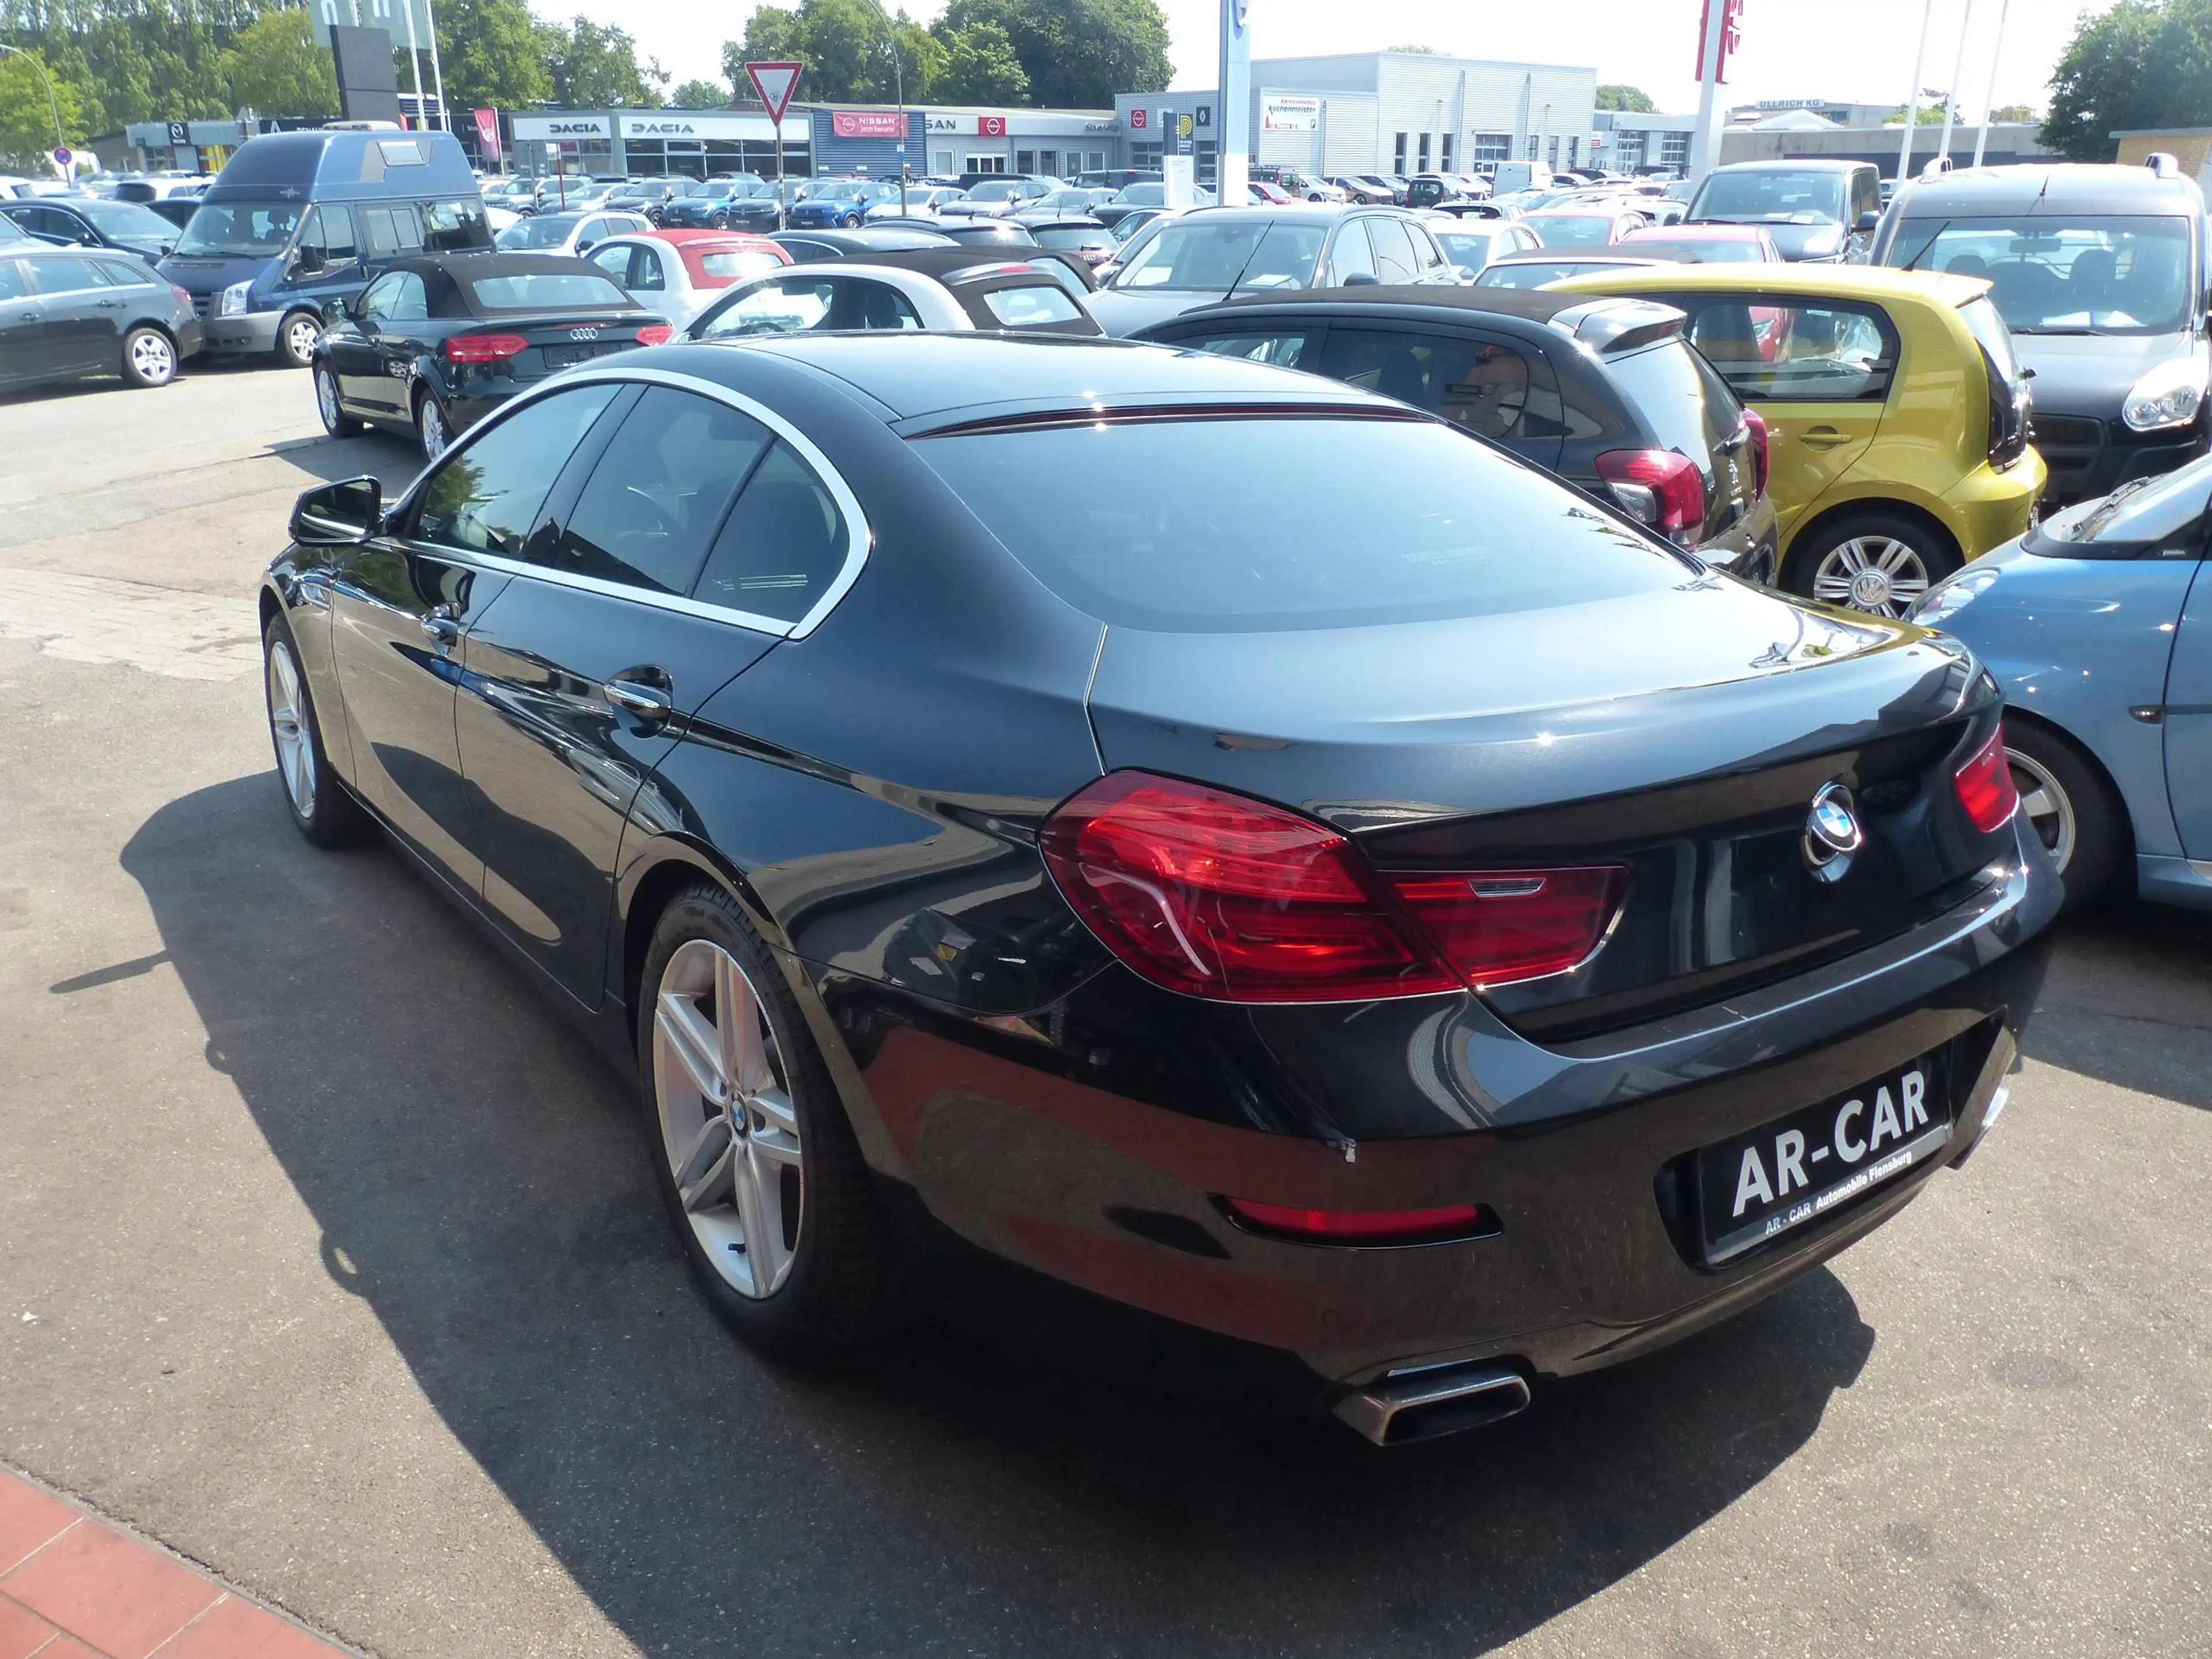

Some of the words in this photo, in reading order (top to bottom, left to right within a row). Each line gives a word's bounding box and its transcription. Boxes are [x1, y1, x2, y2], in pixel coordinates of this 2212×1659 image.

[1760, 100, 1802, 108] ULLRICH
[549, 123, 601, 133] DACIA
[631, 123, 695, 133] DACIA
[1732, 1070, 1929, 1218] AR-CAR
[1765, 1217, 1781, 1235] AR
[1789, 1202, 1812, 1222] CAR
[1816, 1173, 1868, 1210] Automobile
[1869, 1150, 1912, 1181] Flensburg
